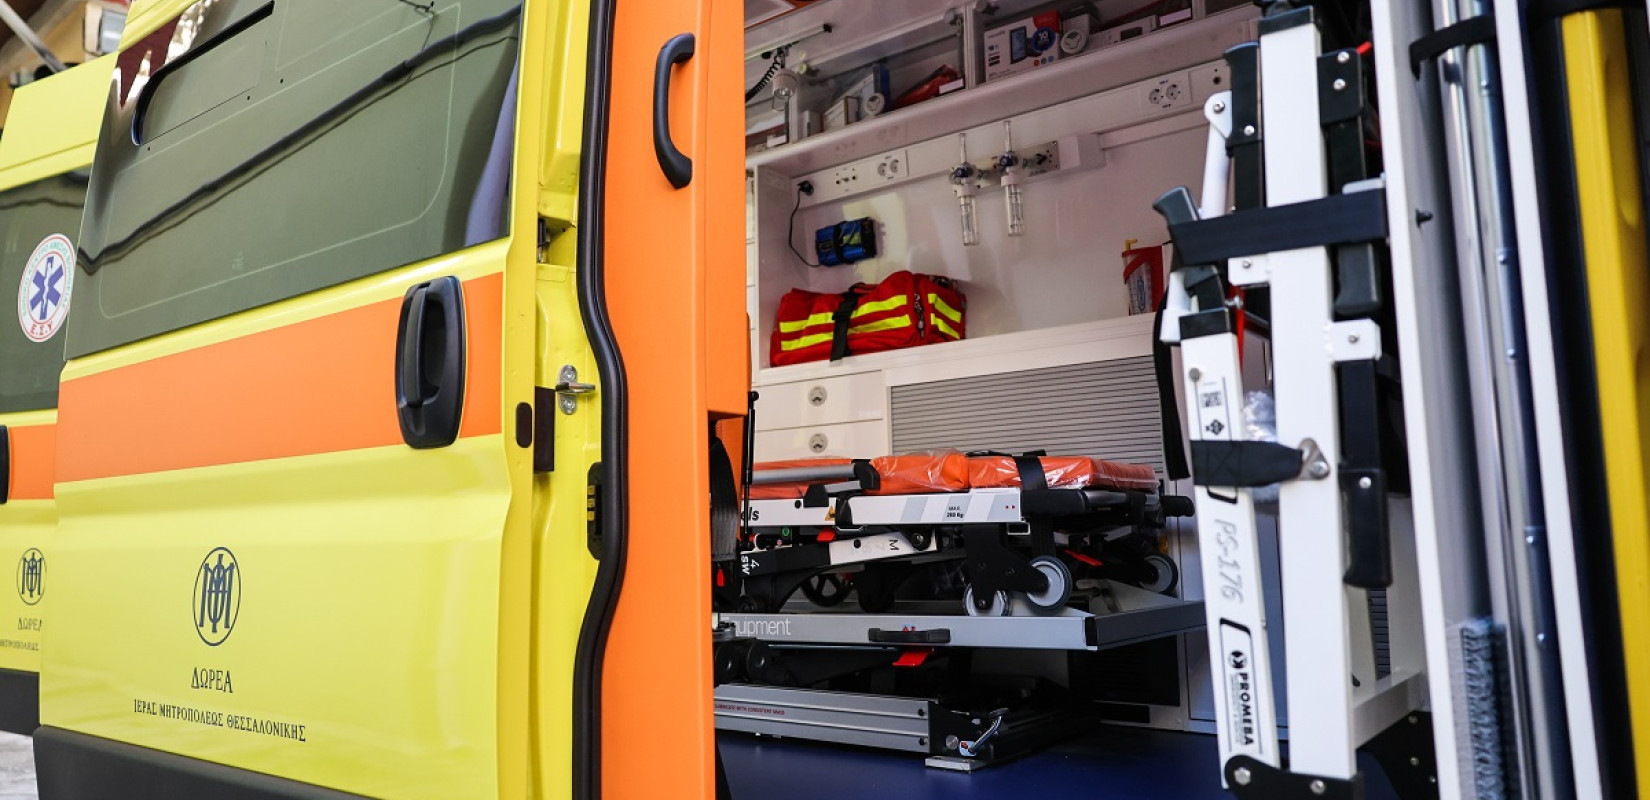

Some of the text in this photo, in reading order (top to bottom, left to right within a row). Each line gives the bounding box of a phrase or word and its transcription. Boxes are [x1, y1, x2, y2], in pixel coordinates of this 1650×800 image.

[1214, 518, 1244, 603] PS-176
[190, 666, 233, 694] ΔΩΡΕΑ
[1238, 672, 1255, 746] PROMEBA
[133, 698, 306, 742] ΙΕΡΑΣ ΜΗΤΡΟΠΟΛΕΩΣ ΘΕΣΣΑΛΟΝΙΚΗΣ
